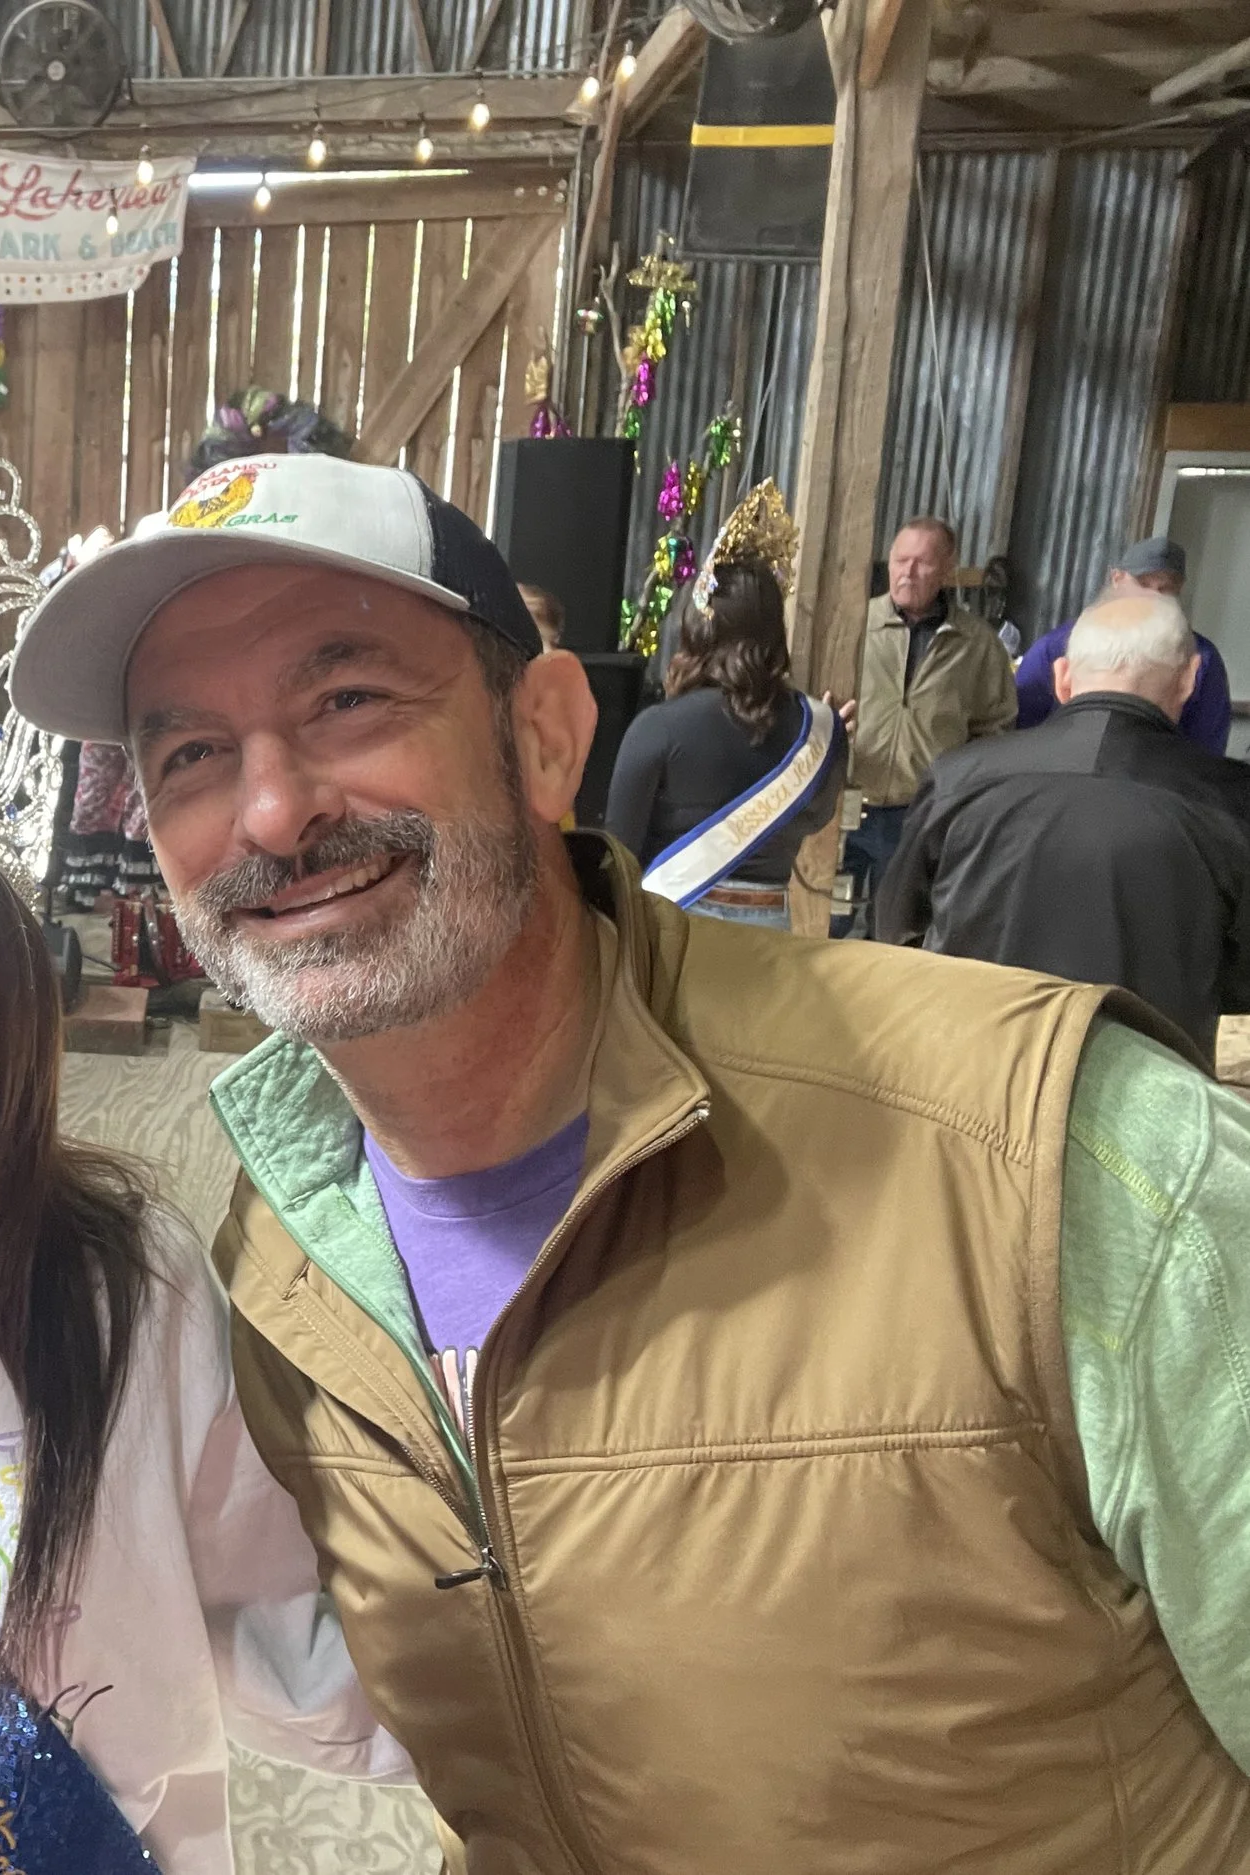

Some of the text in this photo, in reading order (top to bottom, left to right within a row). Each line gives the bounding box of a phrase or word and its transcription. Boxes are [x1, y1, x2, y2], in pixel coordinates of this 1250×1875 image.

[78, 235, 97, 260] &
[224, 512, 298, 528] GRAS
[728, 783, 790, 846] Jessica
